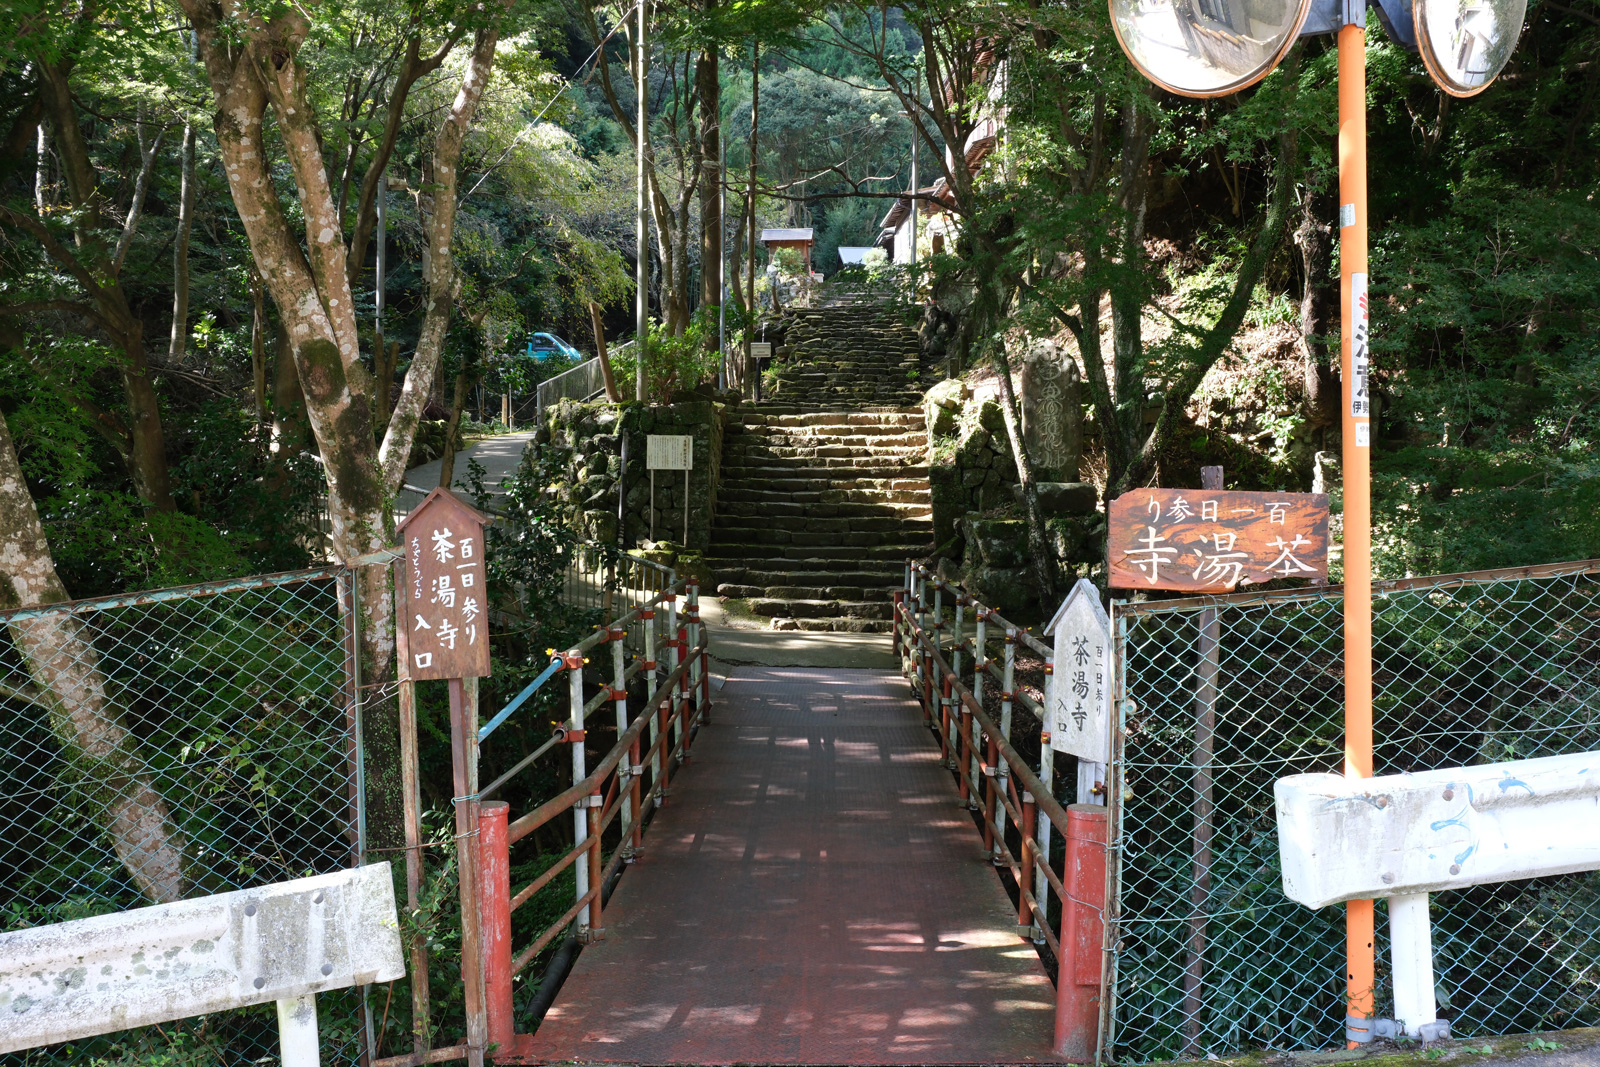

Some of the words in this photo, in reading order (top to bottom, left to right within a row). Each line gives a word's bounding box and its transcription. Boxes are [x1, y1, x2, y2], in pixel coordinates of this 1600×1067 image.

[1147, 494, 1292, 526] 百一日参り
[430, 527, 460, 650] 茶湯寺
[1123, 525, 1319, 589] 茶湯寺
[456, 537, 480, 646] 百一日参り
[414, 613, 433, 669] 入口
[1057, 698, 1069, 733] 入口
[1070, 635, 1091, 733] 茶湯寺
